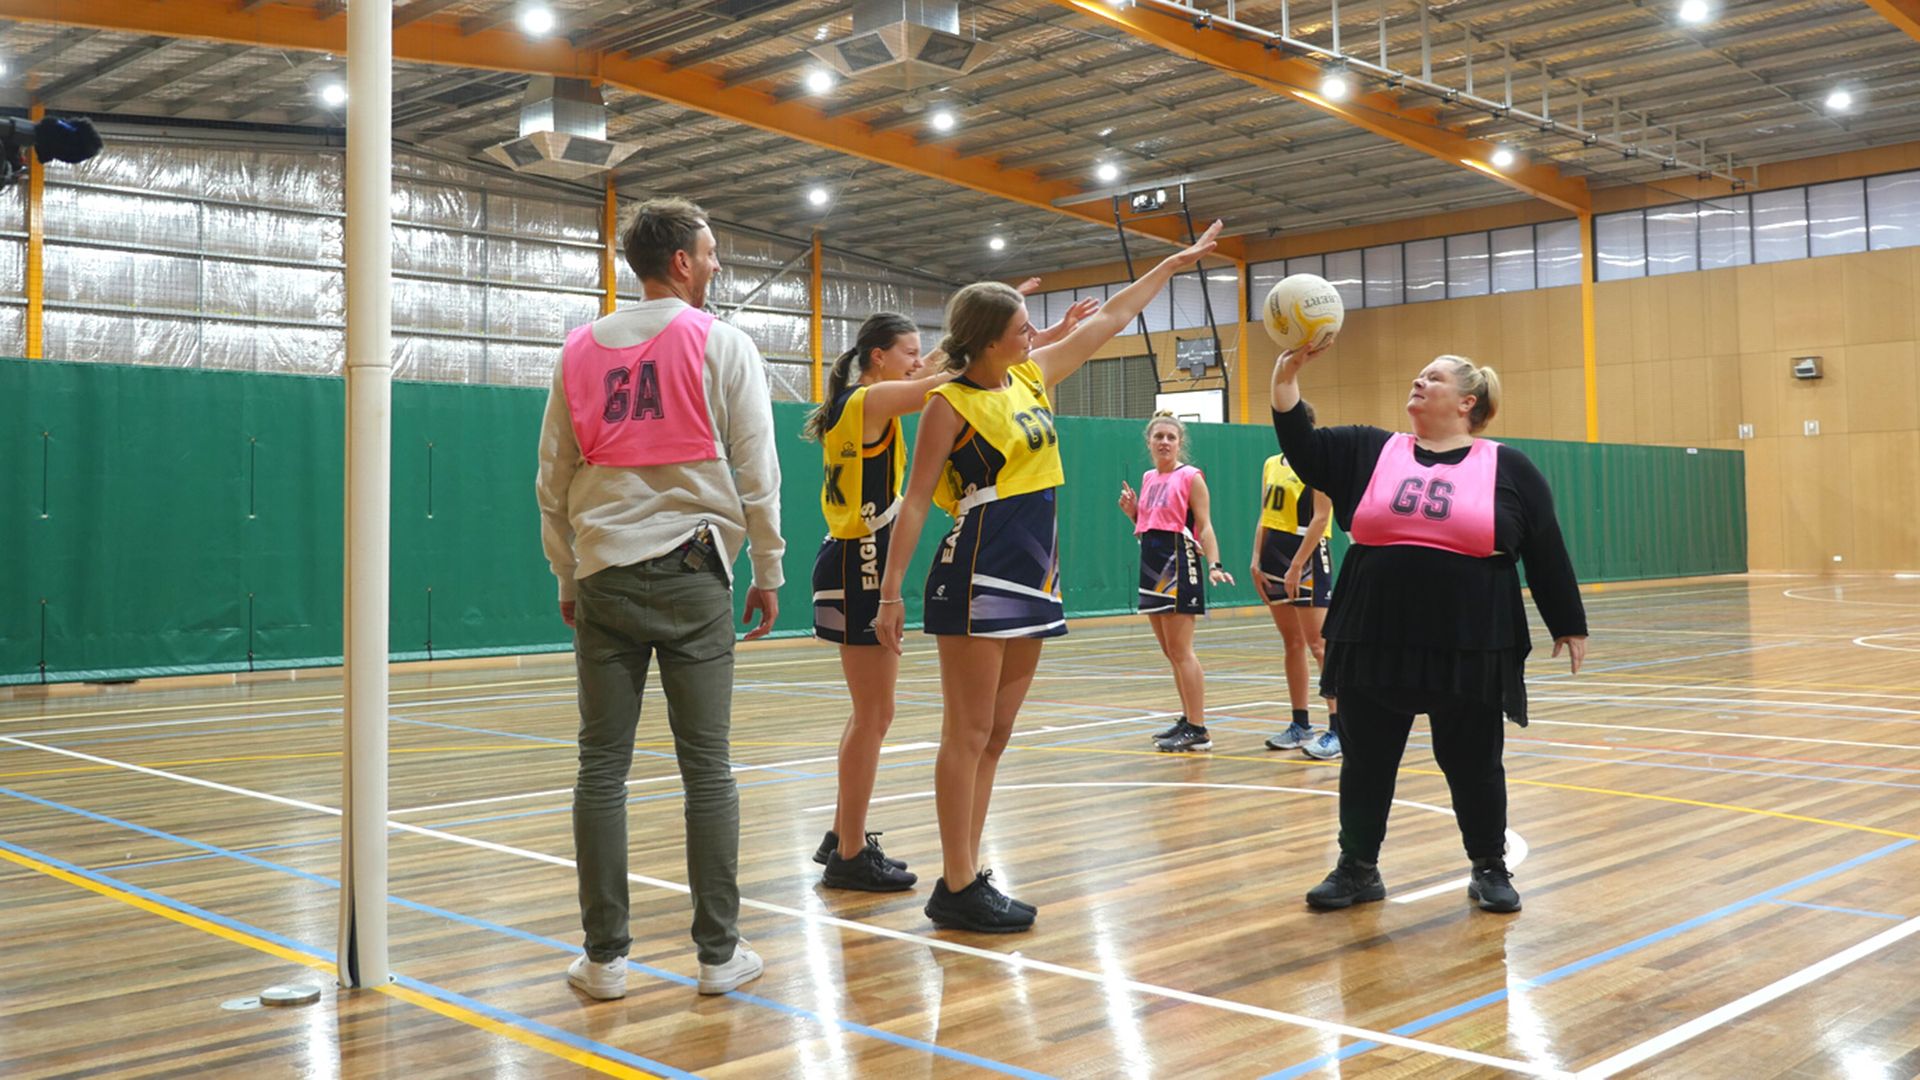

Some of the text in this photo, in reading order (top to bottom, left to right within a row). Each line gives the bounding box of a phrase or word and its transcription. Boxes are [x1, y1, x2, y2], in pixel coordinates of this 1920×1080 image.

[603, 360, 664, 424] GA
[824, 463, 847, 507] K
[1389, 477, 1455, 521] GS
[1184, 537, 1198, 586] AGLES
